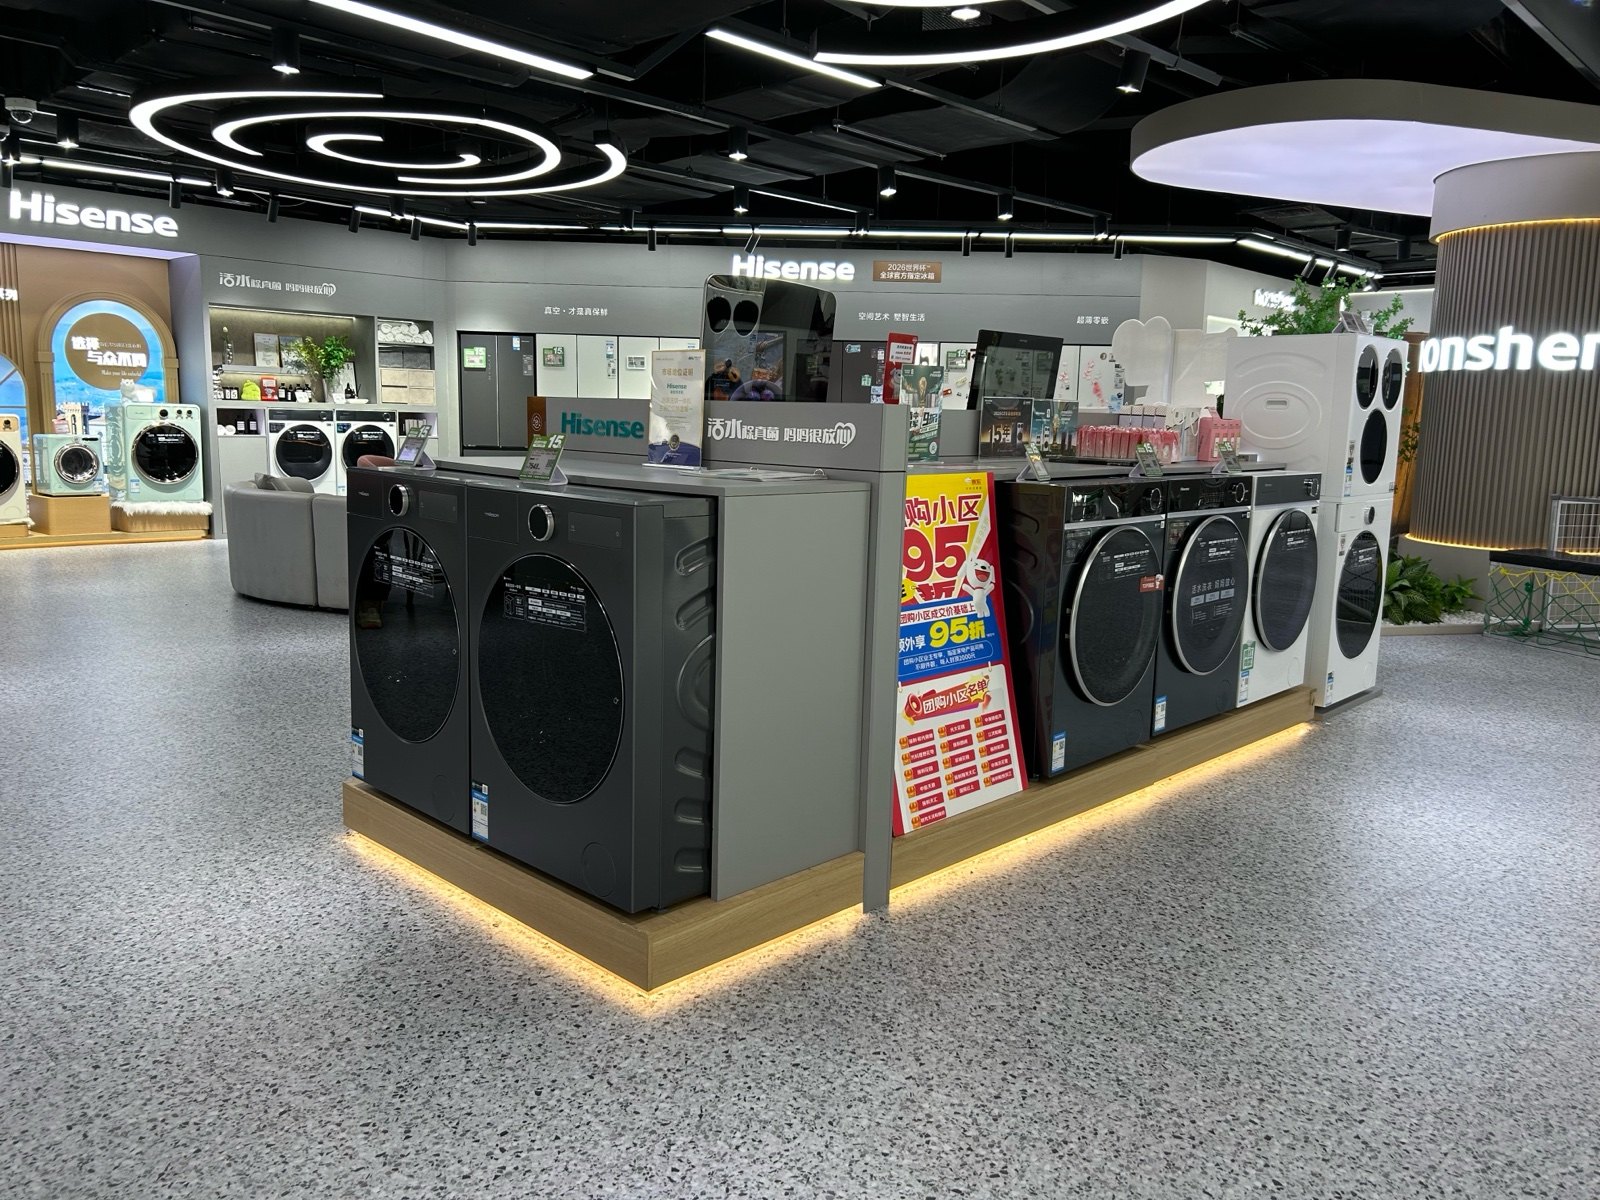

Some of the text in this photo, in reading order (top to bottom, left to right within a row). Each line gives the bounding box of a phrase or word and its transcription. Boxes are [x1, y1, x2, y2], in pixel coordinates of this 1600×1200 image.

[9, 189, 179, 238] Hisense
[732, 254, 855, 281] Hisense
[880, 271, 935, 280] 全球官方指定冰箱
[858, 312, 890, 321] 空间艺术
[1418, 325, 1600, 373] onshe
[666, 383, 687, 391] Hisense
[561, 412, 645, 439] Hisense
[707, 417, 856, 449] 活水除真菌 妈妈很放心
[547, 434, 565, 449] 15
[903, 524, 970, 583] 95
[929, 616, 986, 648] 95折
